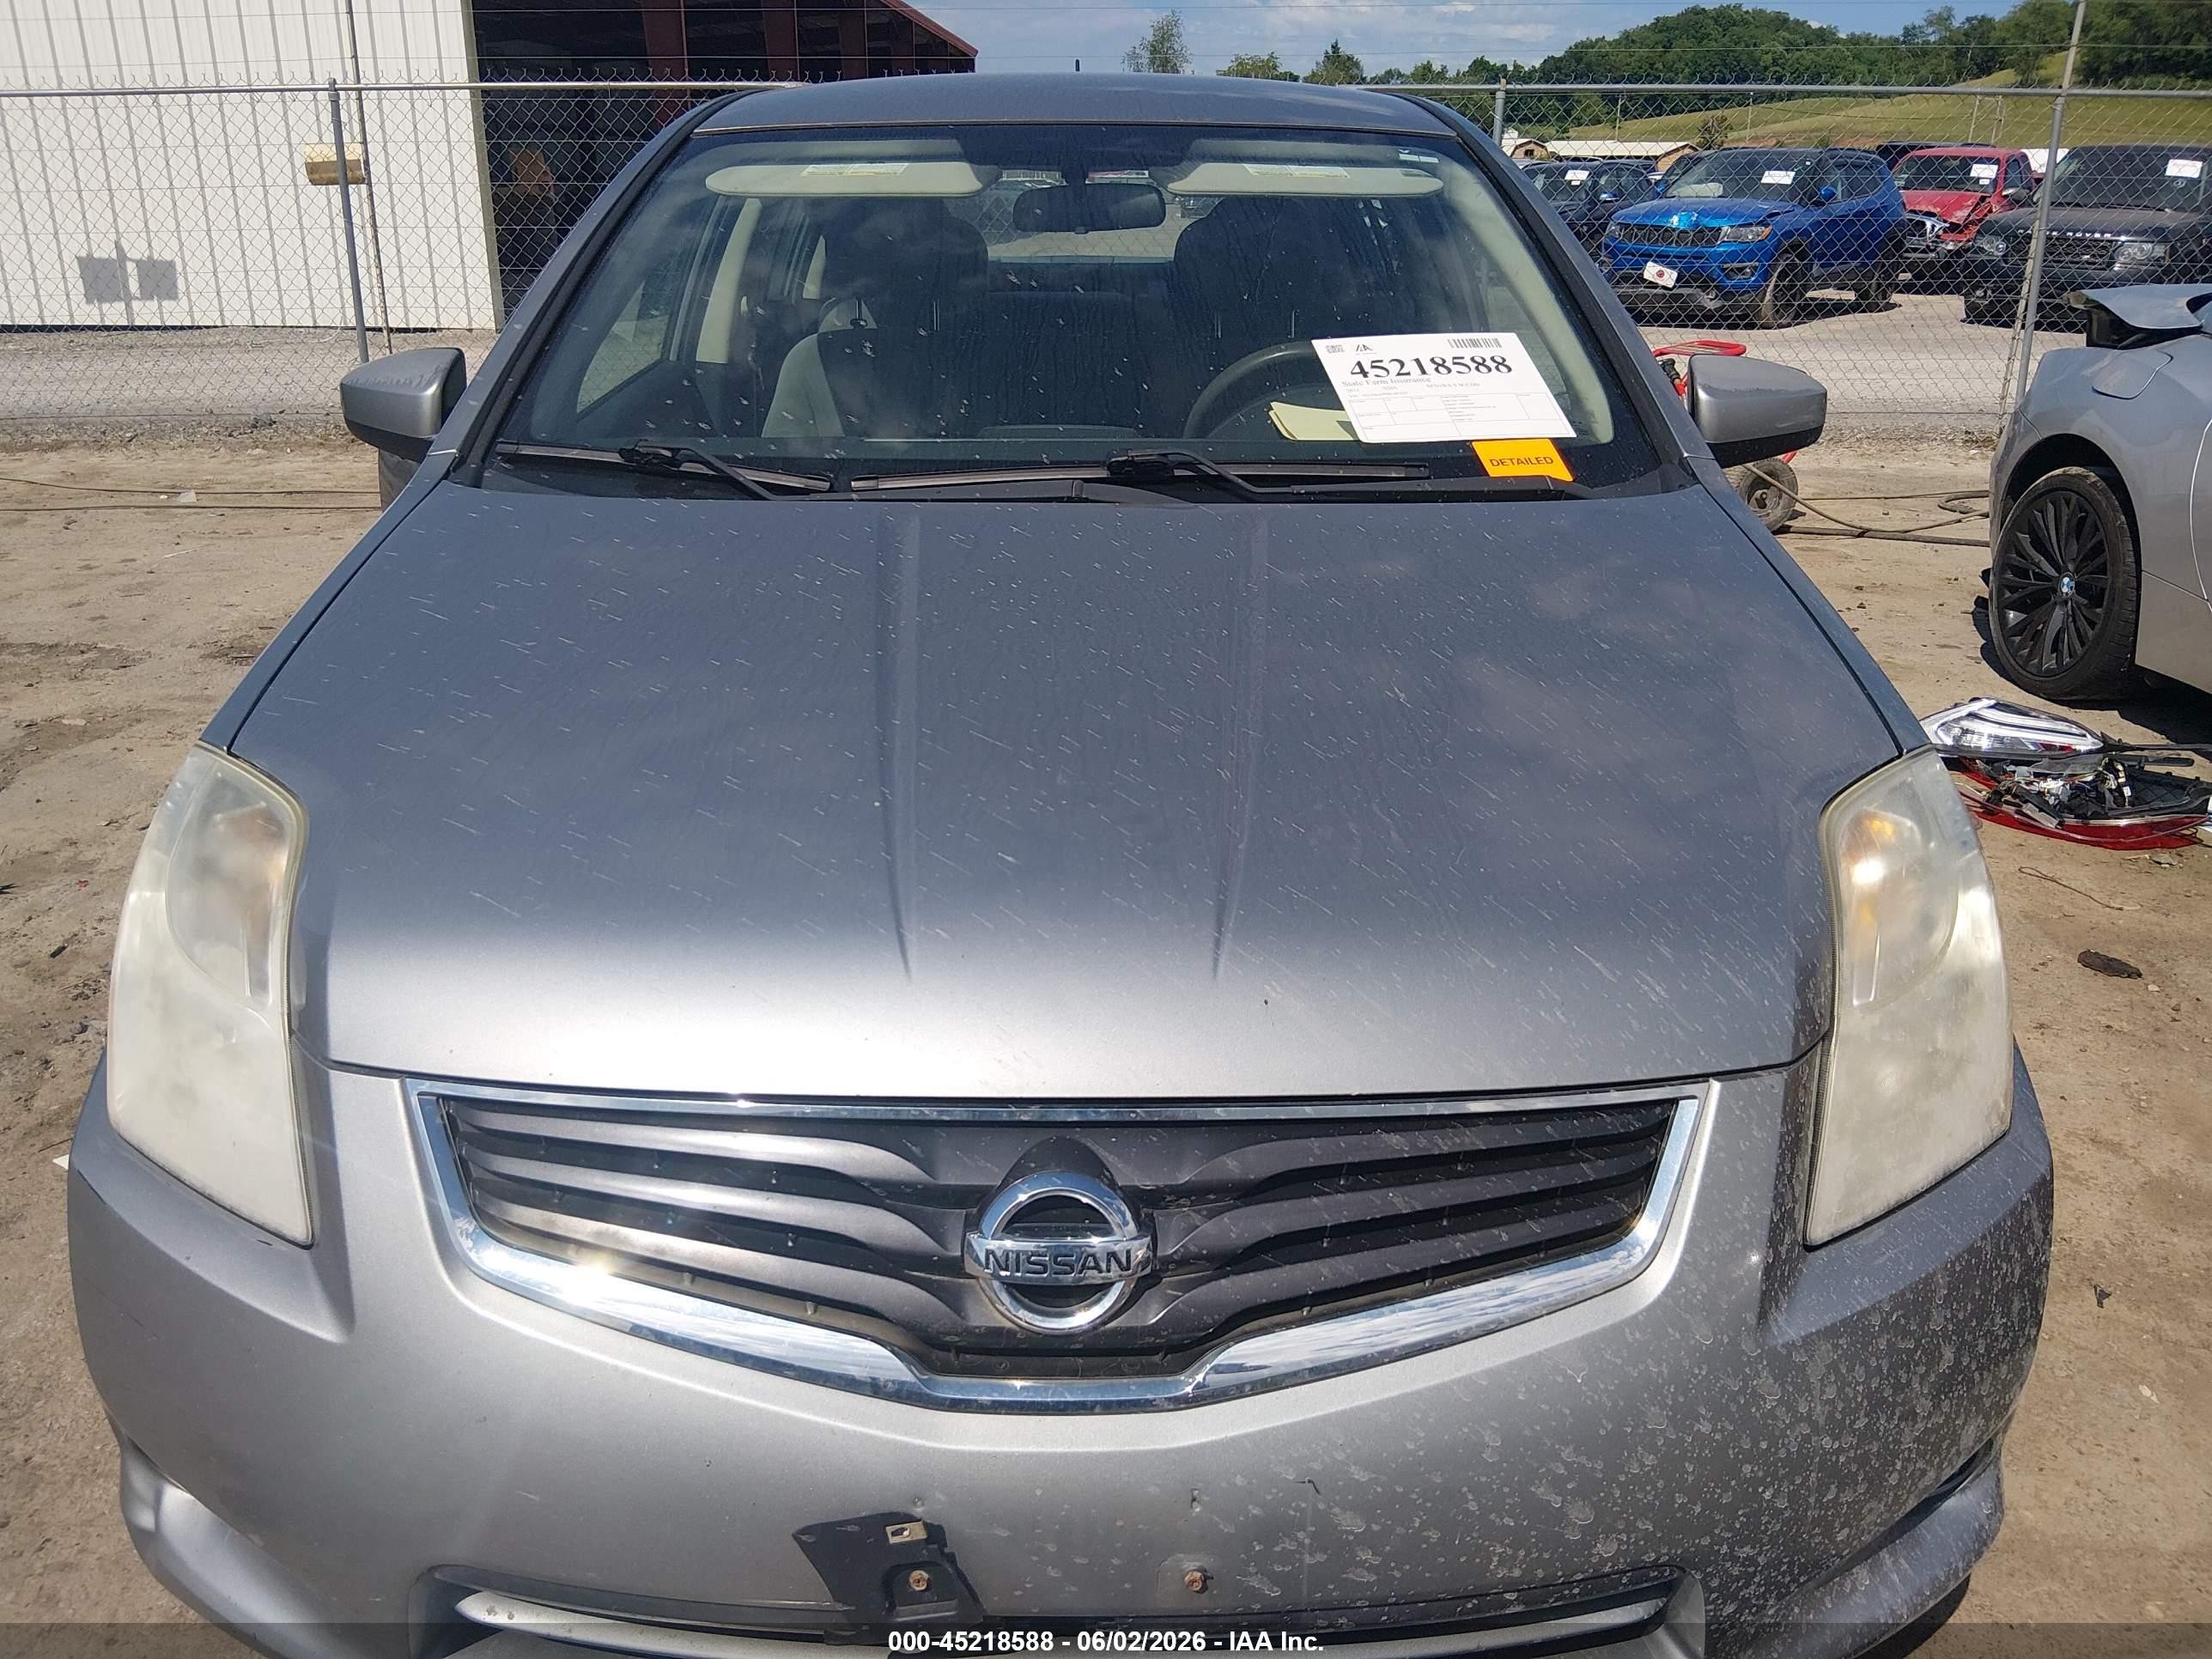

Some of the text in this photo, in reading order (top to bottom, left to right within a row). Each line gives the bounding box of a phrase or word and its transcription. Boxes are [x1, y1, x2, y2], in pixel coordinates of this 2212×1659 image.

[1351, 356, 1512, 378] 45218588
[1365, 377, 1389, 386] Farm
[1489, 456, 1554, 466] DETAILED
[983, 1248, 1132, 1276] NISSAN
